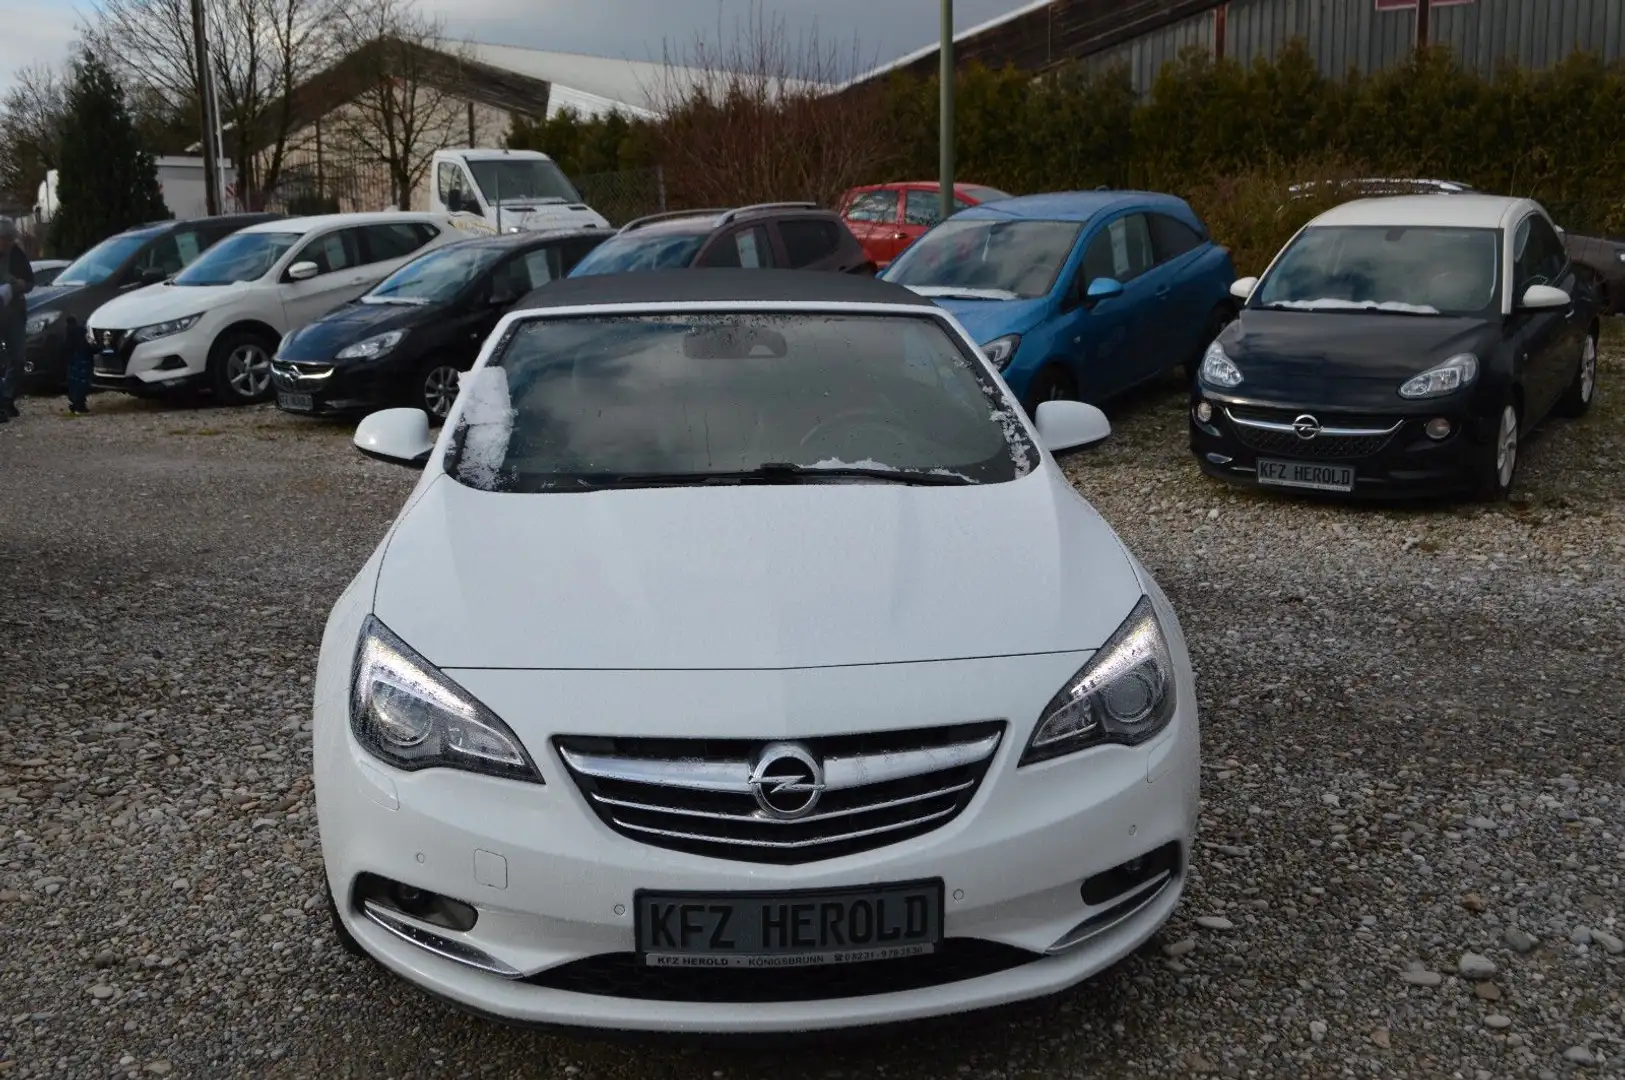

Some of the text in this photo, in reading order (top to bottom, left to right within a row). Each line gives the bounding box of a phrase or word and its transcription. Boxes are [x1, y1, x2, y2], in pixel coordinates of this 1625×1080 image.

[1260, 461, 1287, 479] KFZ
[1294, 465, 1350, 485] HEROLD
[651, 895, 928, 949] KFZ HEROLD
[657, 956, 679, 965] KFZ
[683, 956, 728, 967] HEROLD
[748, 955, 824, 967] KÖNIGSBRUNN
